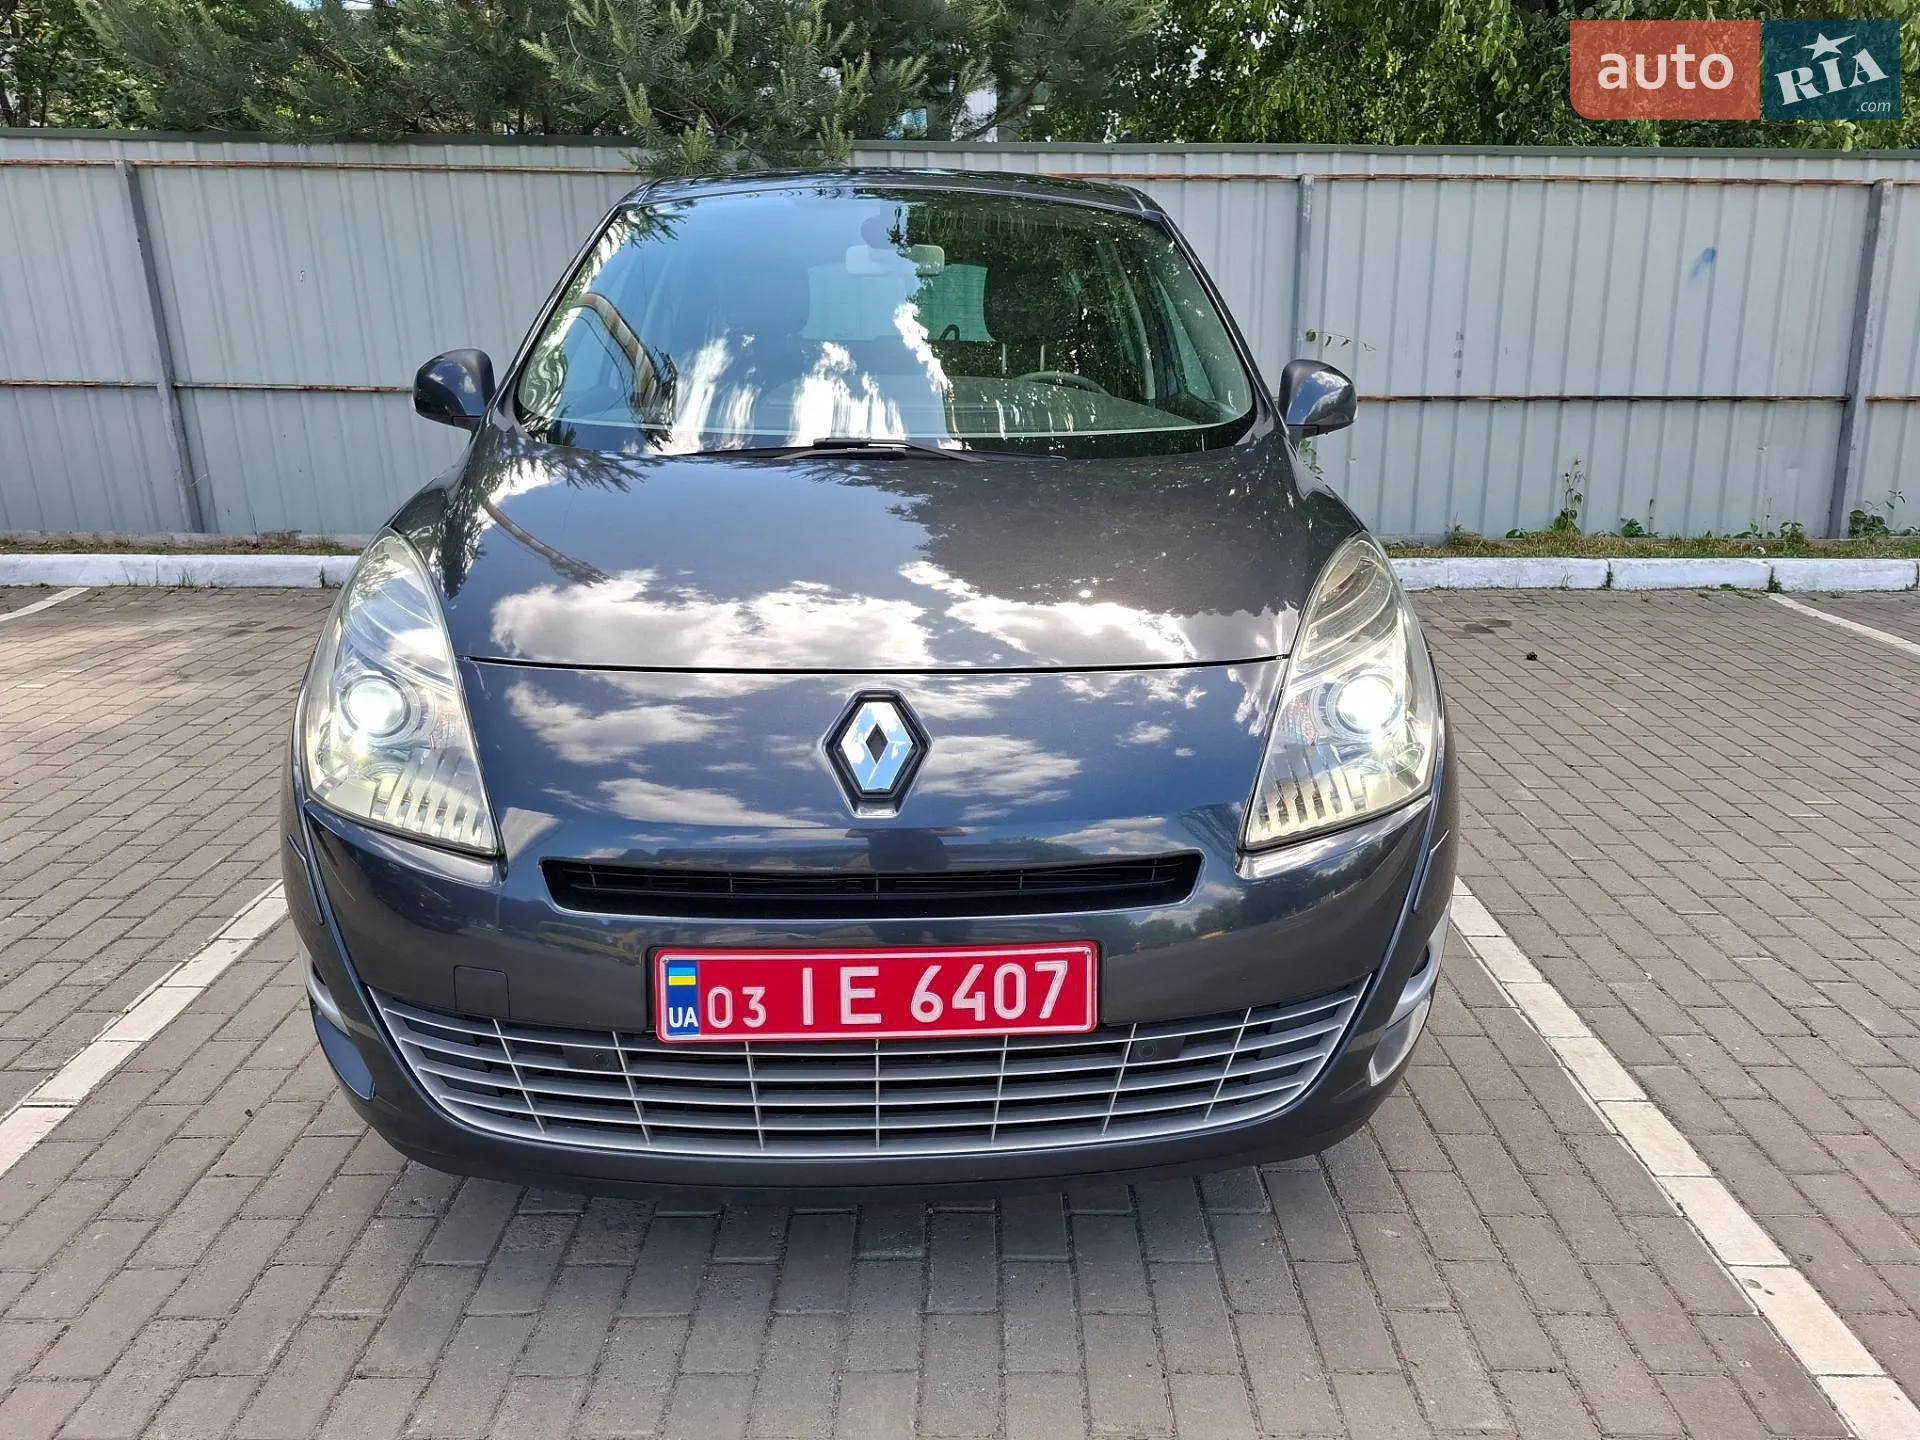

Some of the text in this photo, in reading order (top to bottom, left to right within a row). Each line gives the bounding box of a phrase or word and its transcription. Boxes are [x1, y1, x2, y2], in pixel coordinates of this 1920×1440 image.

[668, 1006, 699, 1028] UA
[707, 960, 1069, 1029] 03 IE 6407
